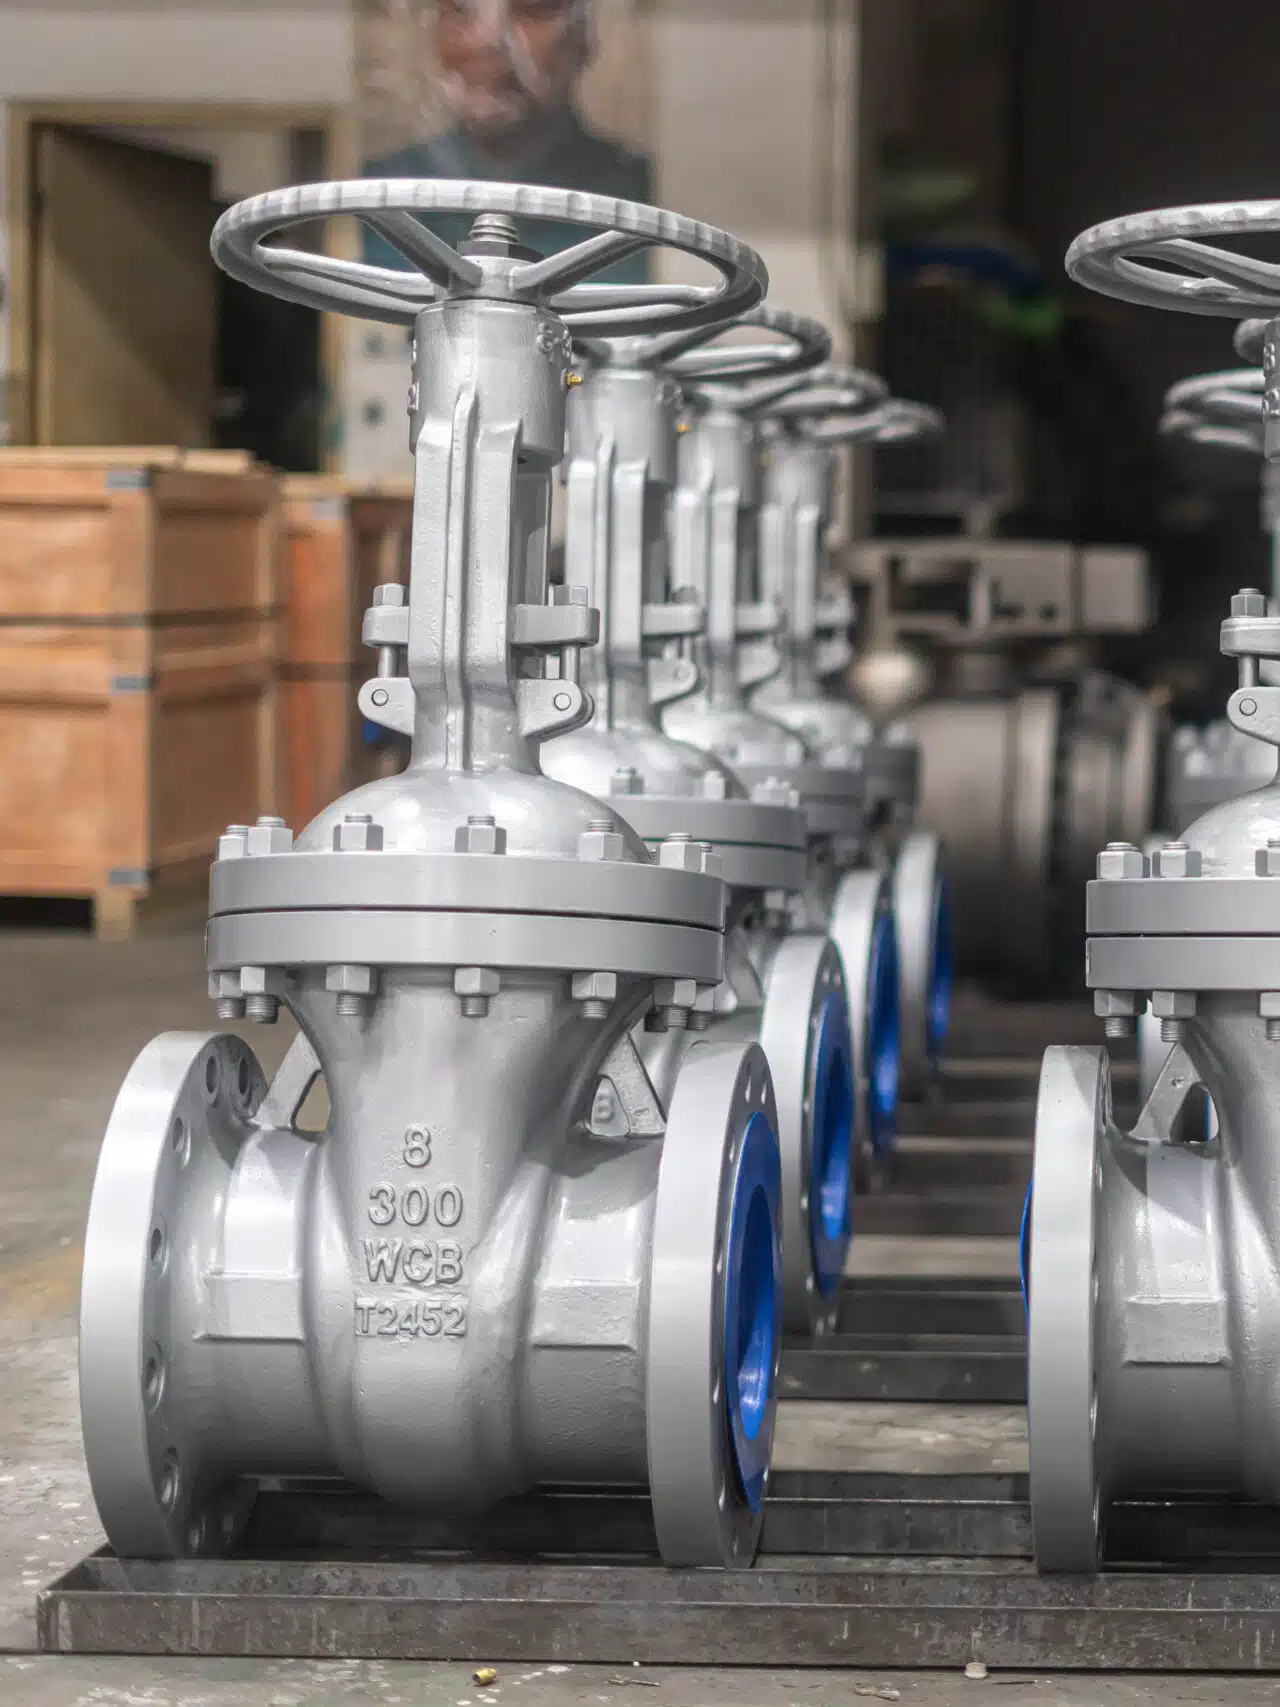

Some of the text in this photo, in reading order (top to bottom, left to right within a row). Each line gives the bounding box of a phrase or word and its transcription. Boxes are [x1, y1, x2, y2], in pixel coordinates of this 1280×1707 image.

[403, 1124, 432, 1168] 8
[368, 1182, 464, 1227] 300
[363, 1238, 464, 1285] WCB
[354, 1299, 468, 1337] T2452
